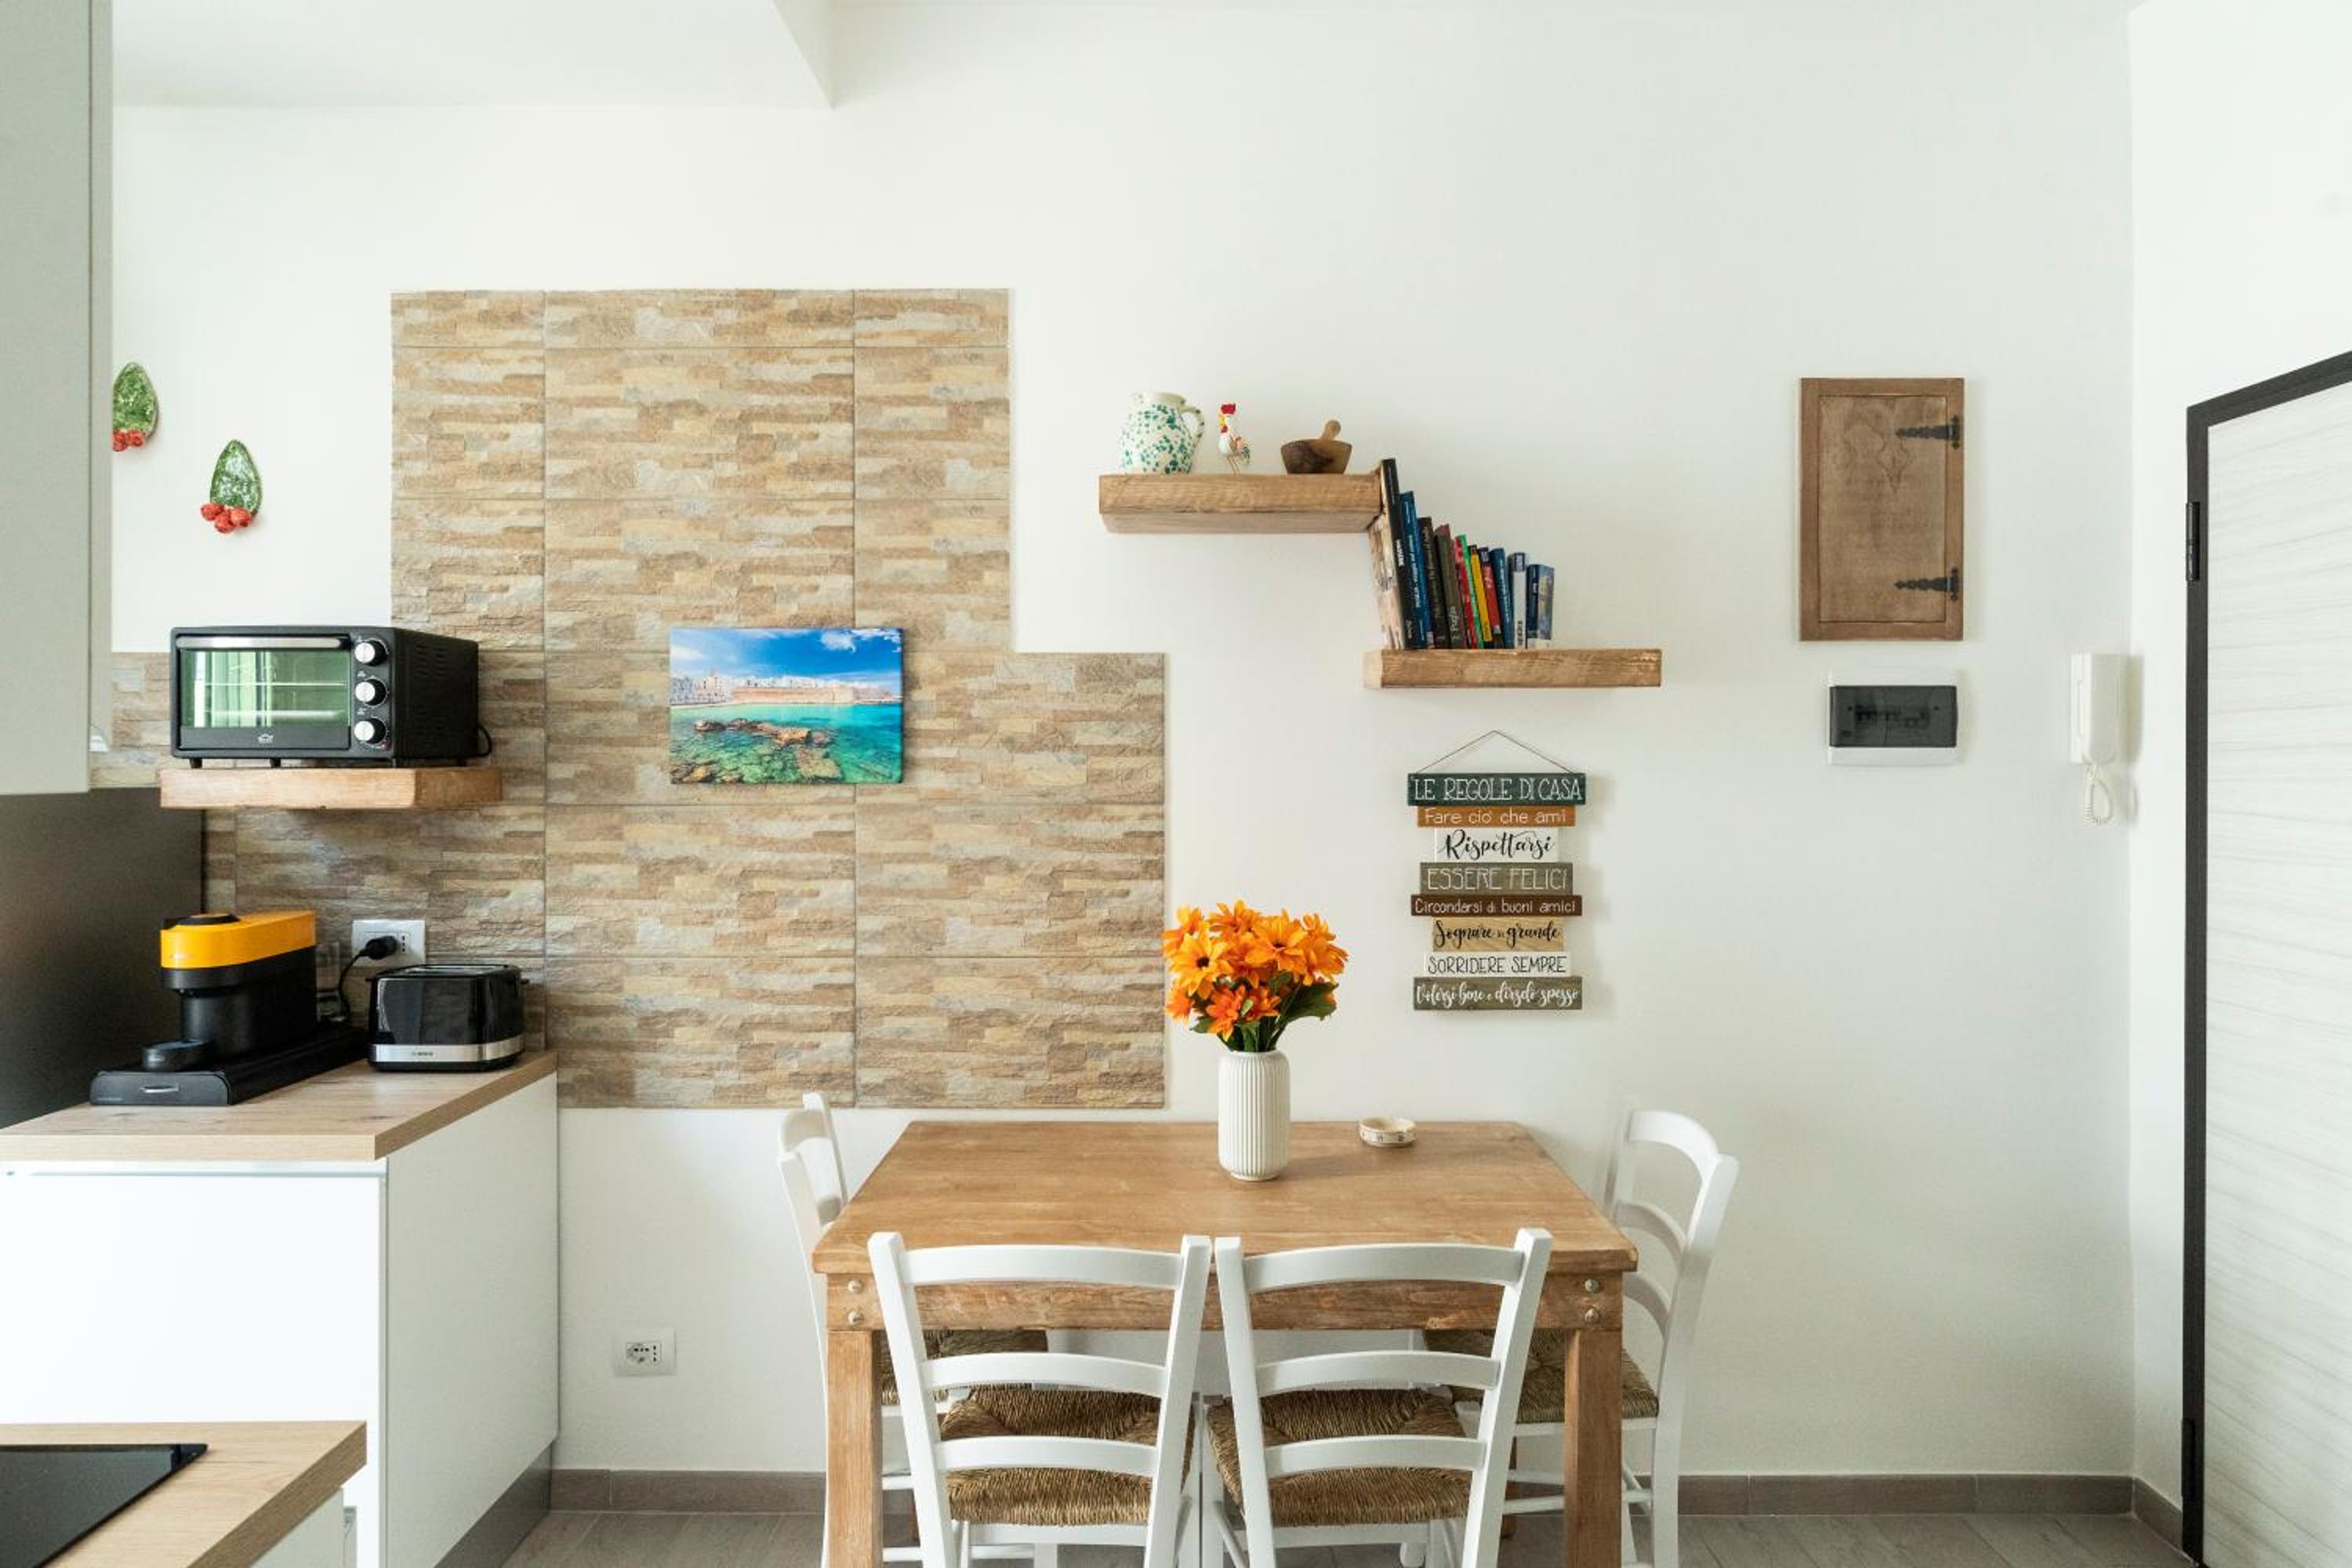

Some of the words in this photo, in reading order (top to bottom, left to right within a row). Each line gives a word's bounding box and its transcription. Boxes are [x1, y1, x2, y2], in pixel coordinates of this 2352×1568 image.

[1414, 778, 1436, 800] LE
[1443, 777, 1512, 800] REGOLE
[1519, 777, 1534, 800] DI
[1537, 777, 1582, 800] CASA
[1425, 808, 1462, 824] Fare
[1500, 808, 1529, 824] che
[1534, 809, 1566, 824] ami
[1437, 829, 1556, 861] Rispettarsi
[1427, 868, 1503, 891] ESSERE
[1508, 868, 1568, 891] FELICI
[1414, 898, 1483, 914] Circondarsi
[1501, 898, 1534, 913] buoni
[1539, 899, 1576, 913] amici
[1433, 920, 1494, 949] Sognare
[1505, 920, 1562, 949] grande
[1428, 956, 1506, 974] SORRIDERE
[1511, 956, 1567, 974] SEMPRE
[1537, 989, 1581, 1007] spesso
